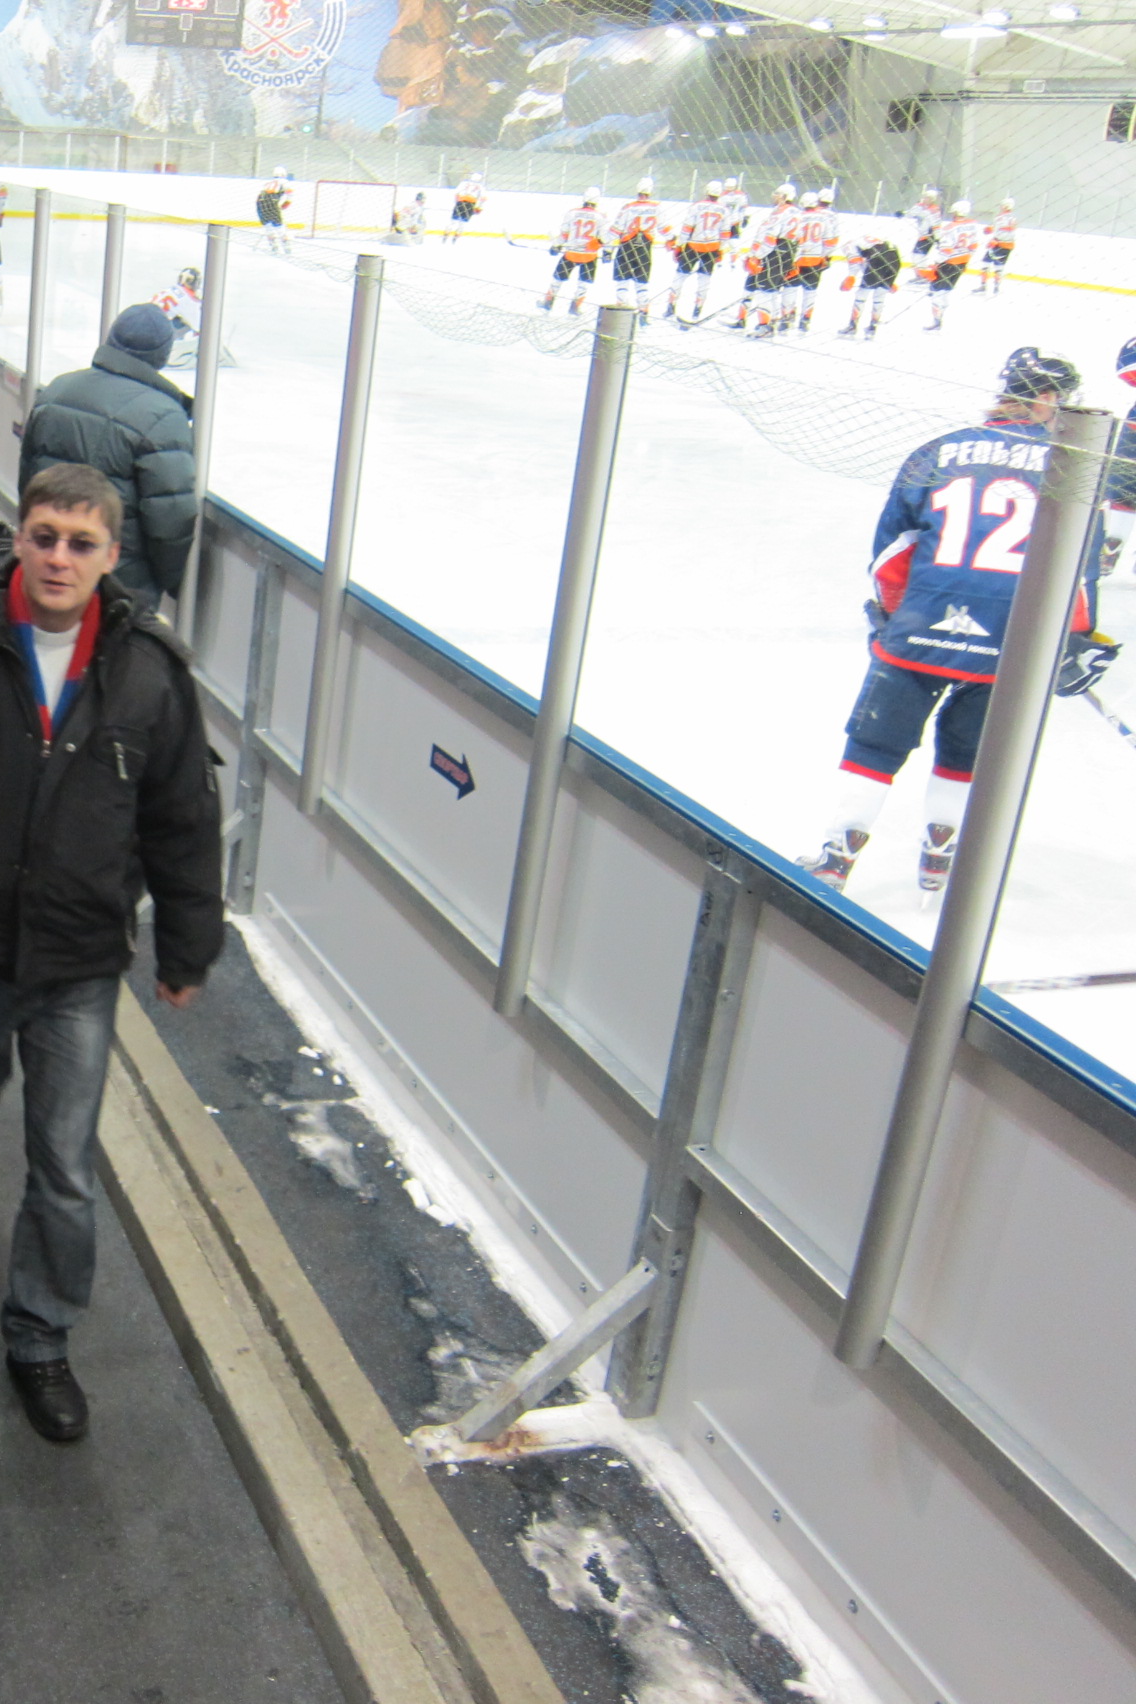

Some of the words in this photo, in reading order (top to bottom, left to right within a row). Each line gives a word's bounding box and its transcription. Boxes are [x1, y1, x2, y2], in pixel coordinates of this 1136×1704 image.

[573, 219, 596, 240] 12
[627, 215, 657, 233] 42
[700, 211, 722, 231] 17
[801, 221, 823, 243] 10
[931, 476, 1039, 574] 12
